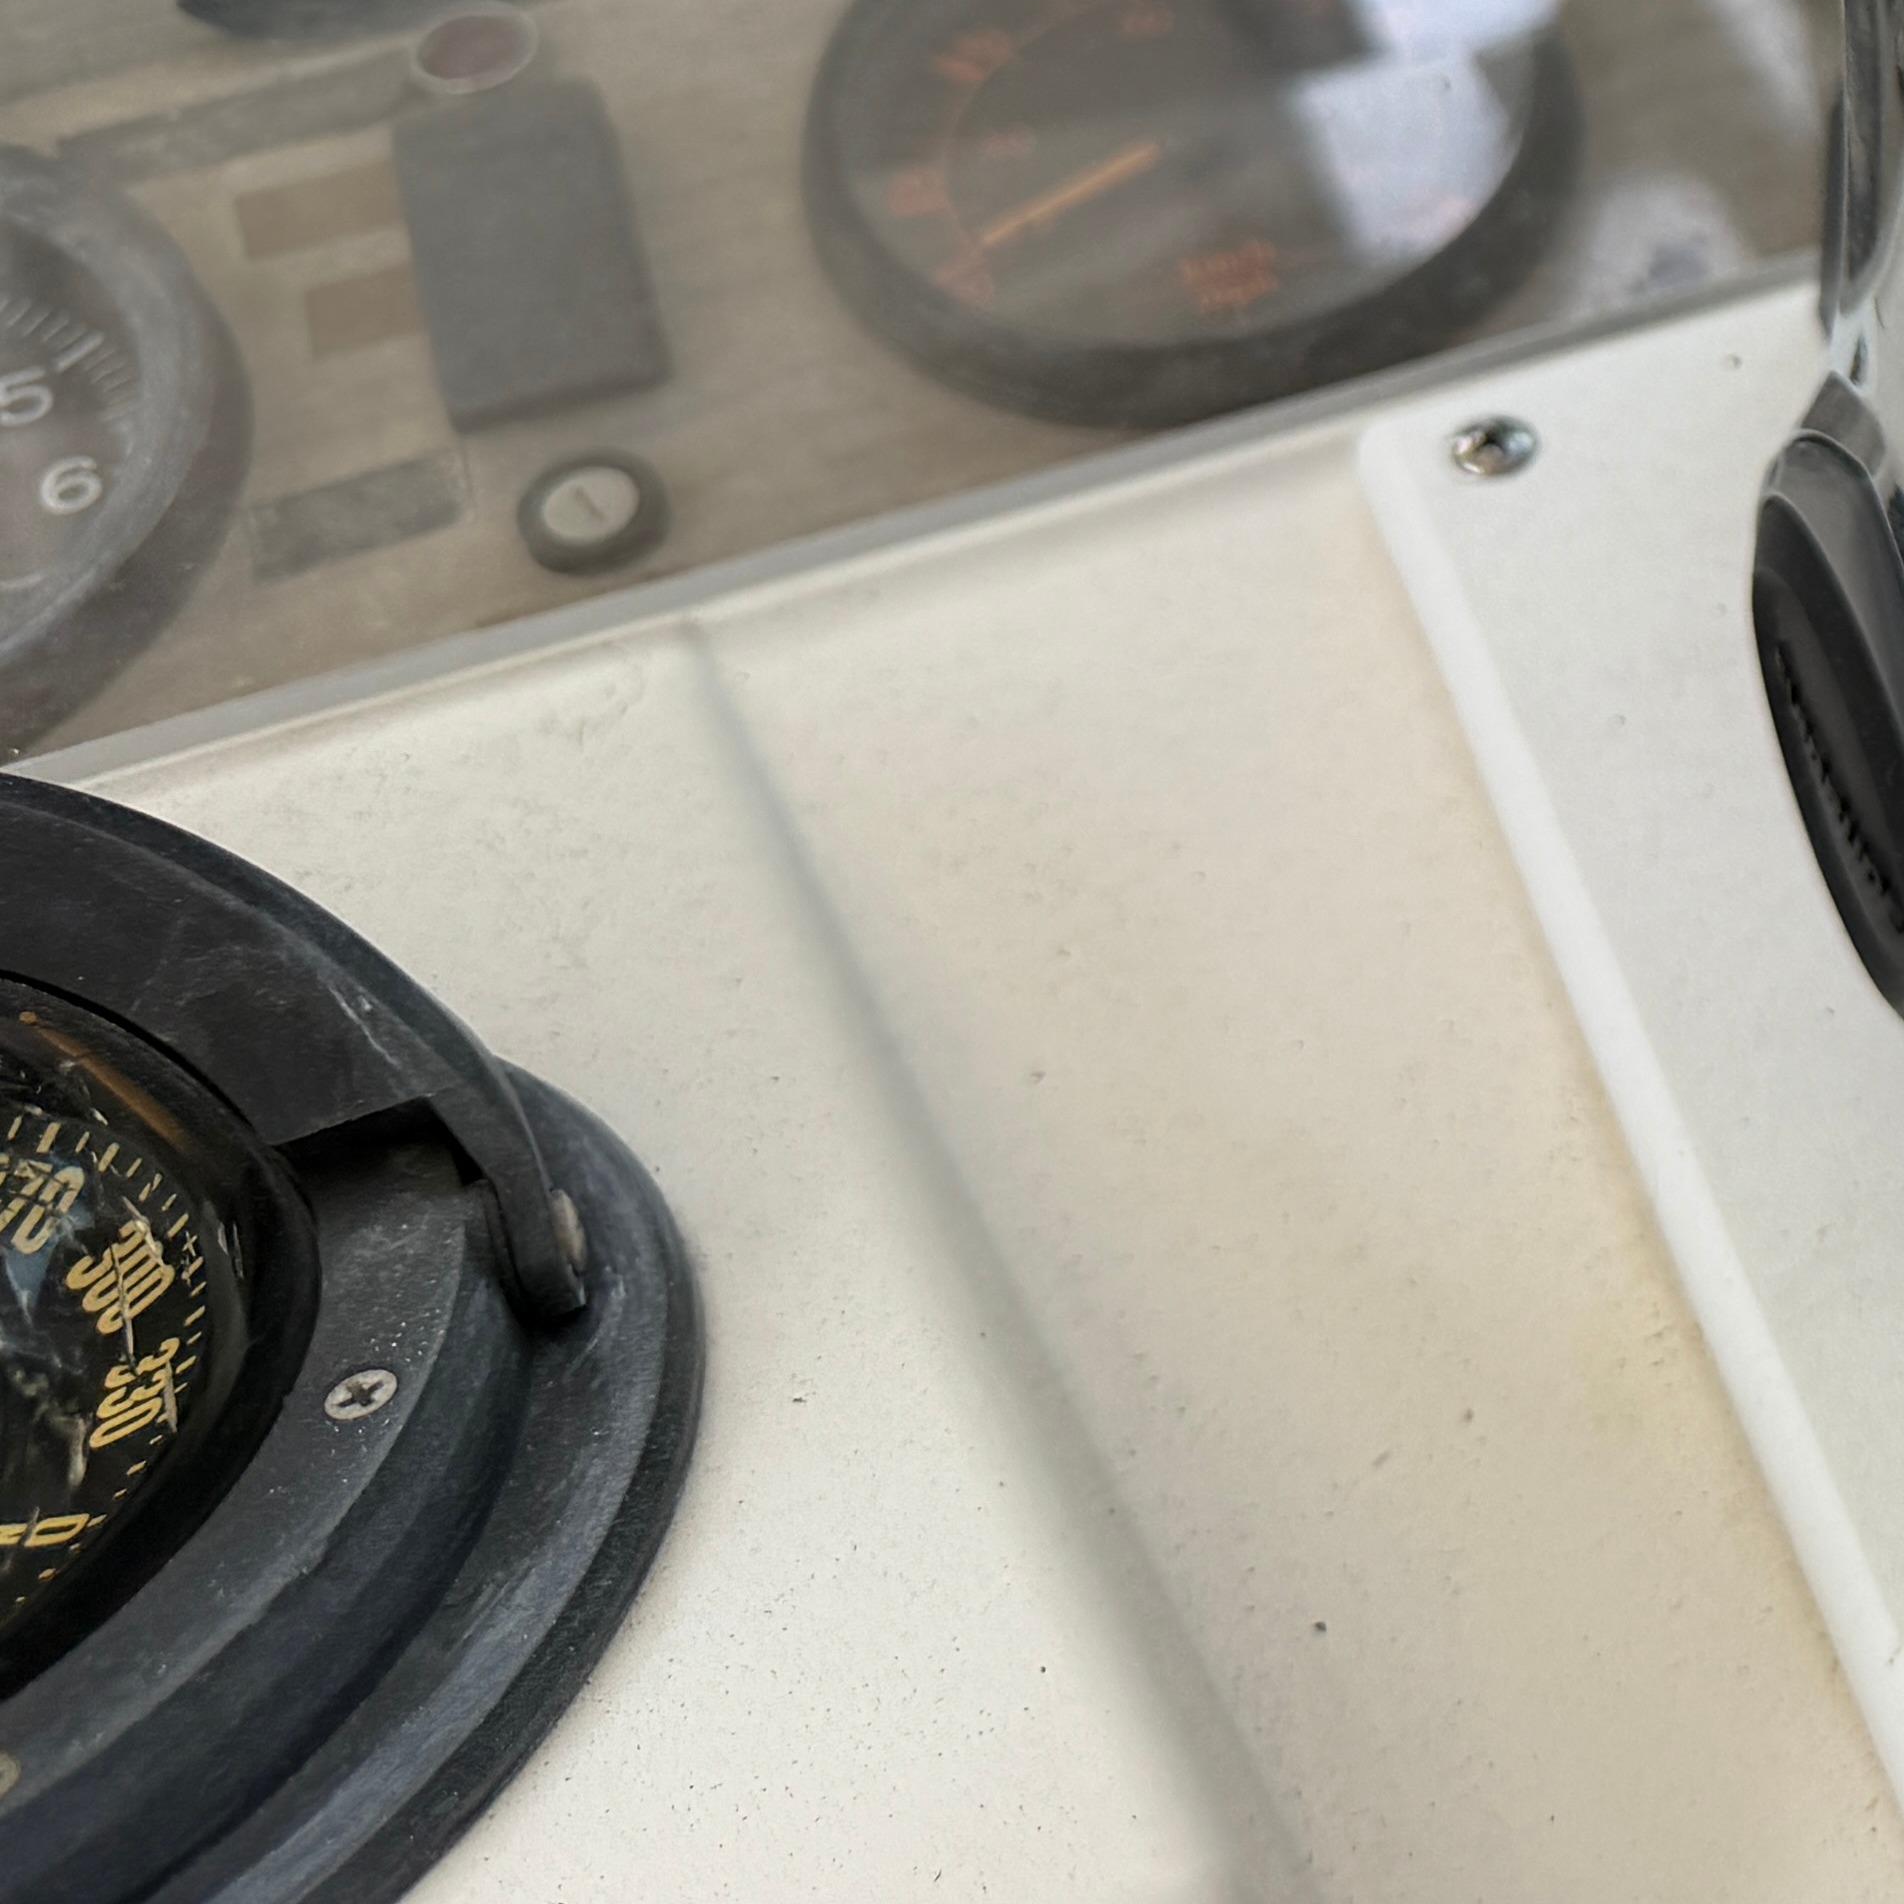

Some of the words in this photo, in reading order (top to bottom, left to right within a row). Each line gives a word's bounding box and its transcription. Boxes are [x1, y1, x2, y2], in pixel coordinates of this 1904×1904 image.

[0, 366, 51, 427] 5
[39, 456, 103, 516] 6
[0, 1153, 85, 1255] 70
[66, 1220, 176, 1335] 300
[89, 1337, 180, 1449] 330
